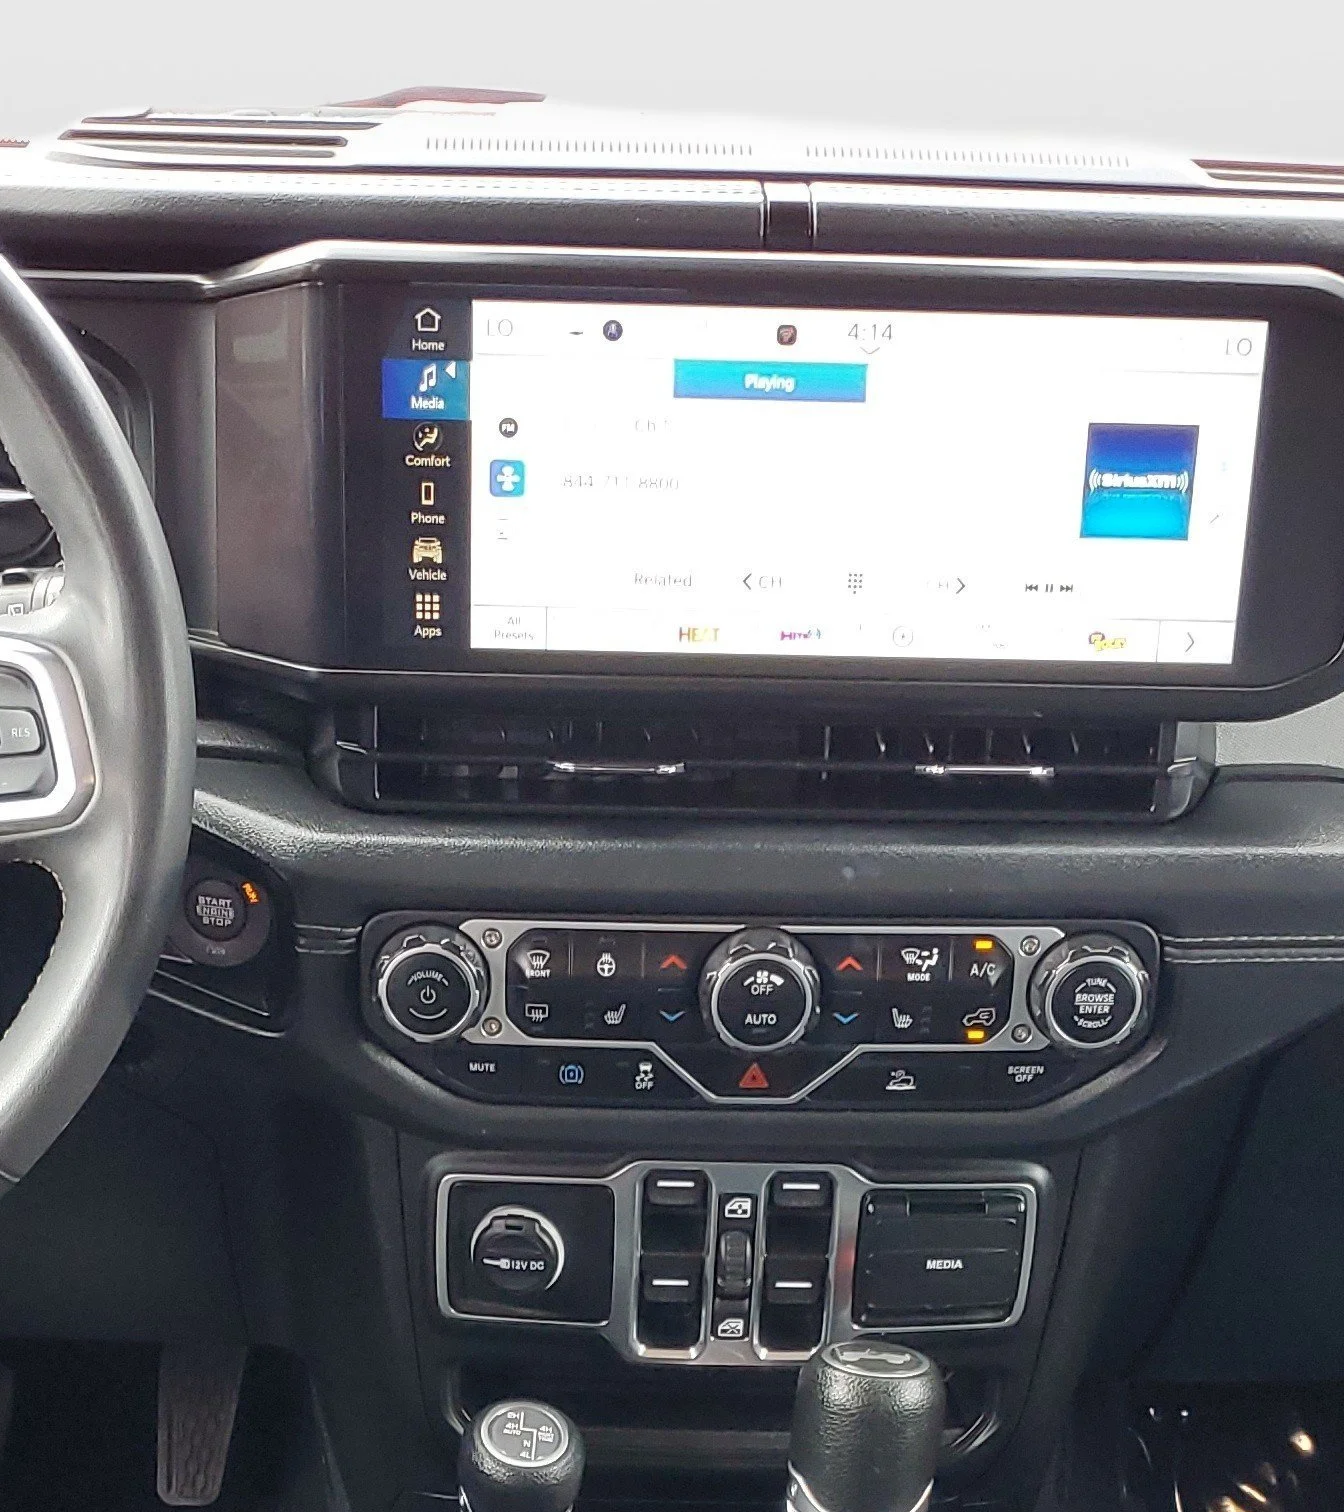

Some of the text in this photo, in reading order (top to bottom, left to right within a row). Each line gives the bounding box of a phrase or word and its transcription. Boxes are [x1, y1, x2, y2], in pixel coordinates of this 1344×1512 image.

[847, 323, 893, 341] 4:14
[411, 337, 445, 351] Home
[744, 372, 796, 392] Playing
[410, 395, 445, 410] Media
[405, 454, 451, 468] Comfort
[410, 510, 446, 525] Phone
[408, 567, 448, 581] Vehicle
[413, 624, 444, 640] Apps
[197, 895, 233, 907] START
[202, 916, 233, 927] STOP
[412, 969, 444, 982] VOLUME
[525, 968, 551, 979] FRONT
[969, 962, 997, 978] A/C
[907, 972, 931, 982] MODE
[750, 984, 774, 996] OFF
[1075, 993, 1115, 1003] BROWSE
[1078, 1005, 1111, 1014] ENTER
[744, 1013, 777, 1025] AUTO
[469, 1062, 496, 1073] MUTE
[1007, 1065, 1045, 1075] SCREEN
[1014, 1074, 1034, 1083] OFF
[635, 1081, 654, 1090] OFF
[511, 1260, 545, 1271] 12V DC
[925, 1259, 964, 1270] MEDIA
[523, 1440, 532, 1448] N
